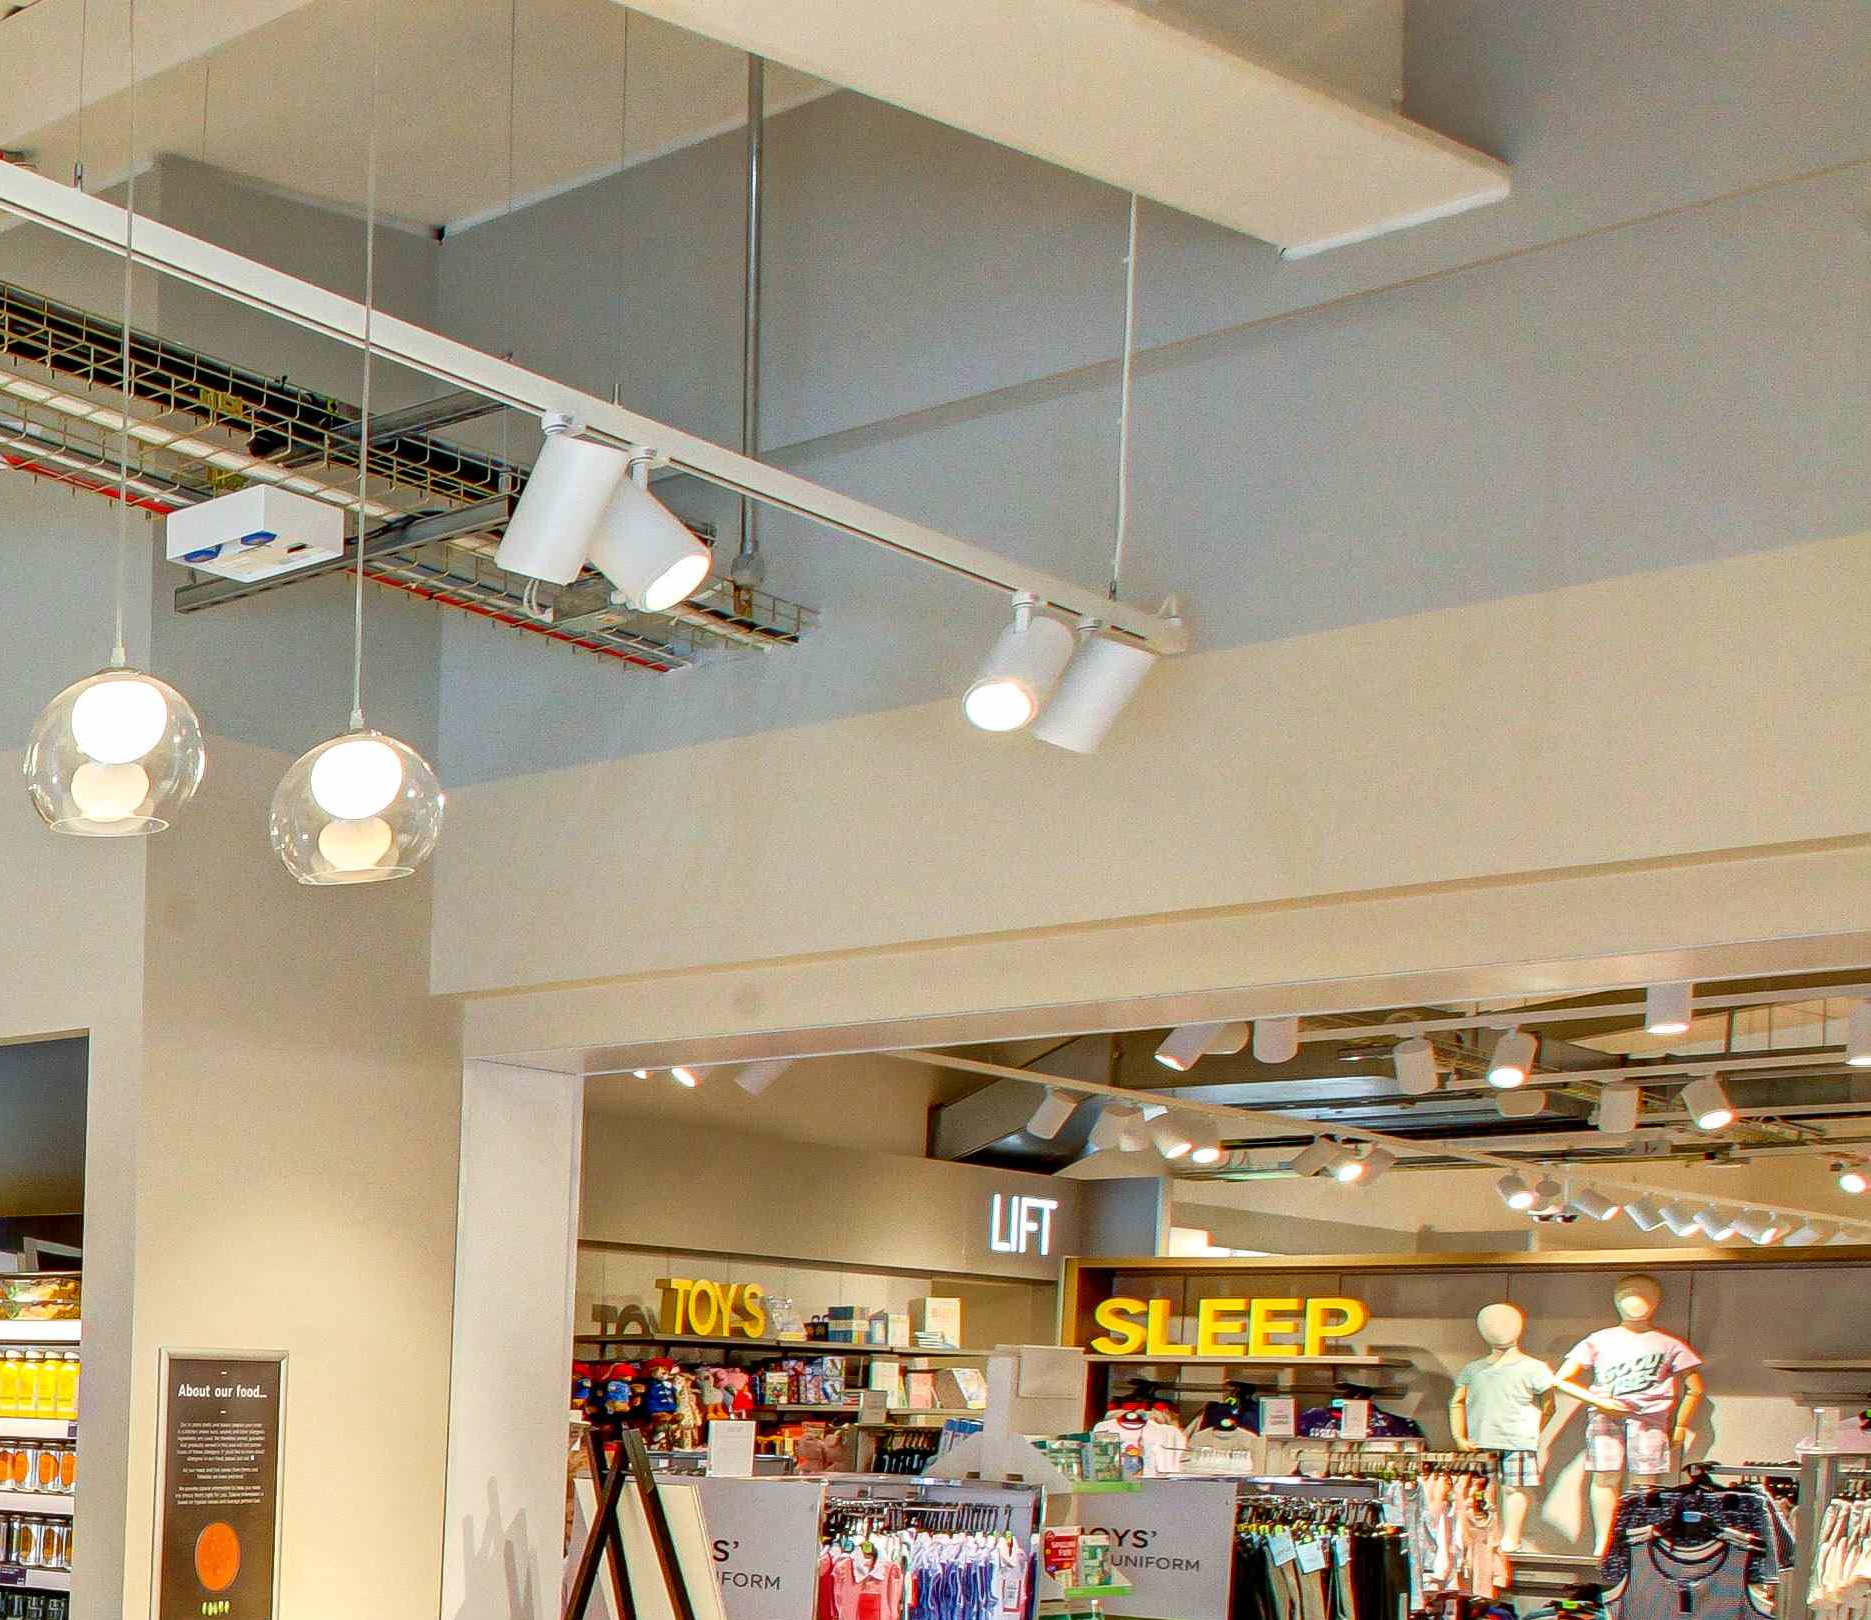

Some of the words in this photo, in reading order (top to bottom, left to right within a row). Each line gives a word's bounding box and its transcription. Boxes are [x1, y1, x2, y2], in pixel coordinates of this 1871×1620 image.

[991, 1192, 1059, 1256] LIFT
[669, 1278, 767, 1340] TOYS
[1092, 1296, 1370, 1358] SLEEP
[177, 1383, 211, 1398] About
[214, 1386, 234, 1398] our
[1110, 1554, 1200, 1573] UNIFORM
